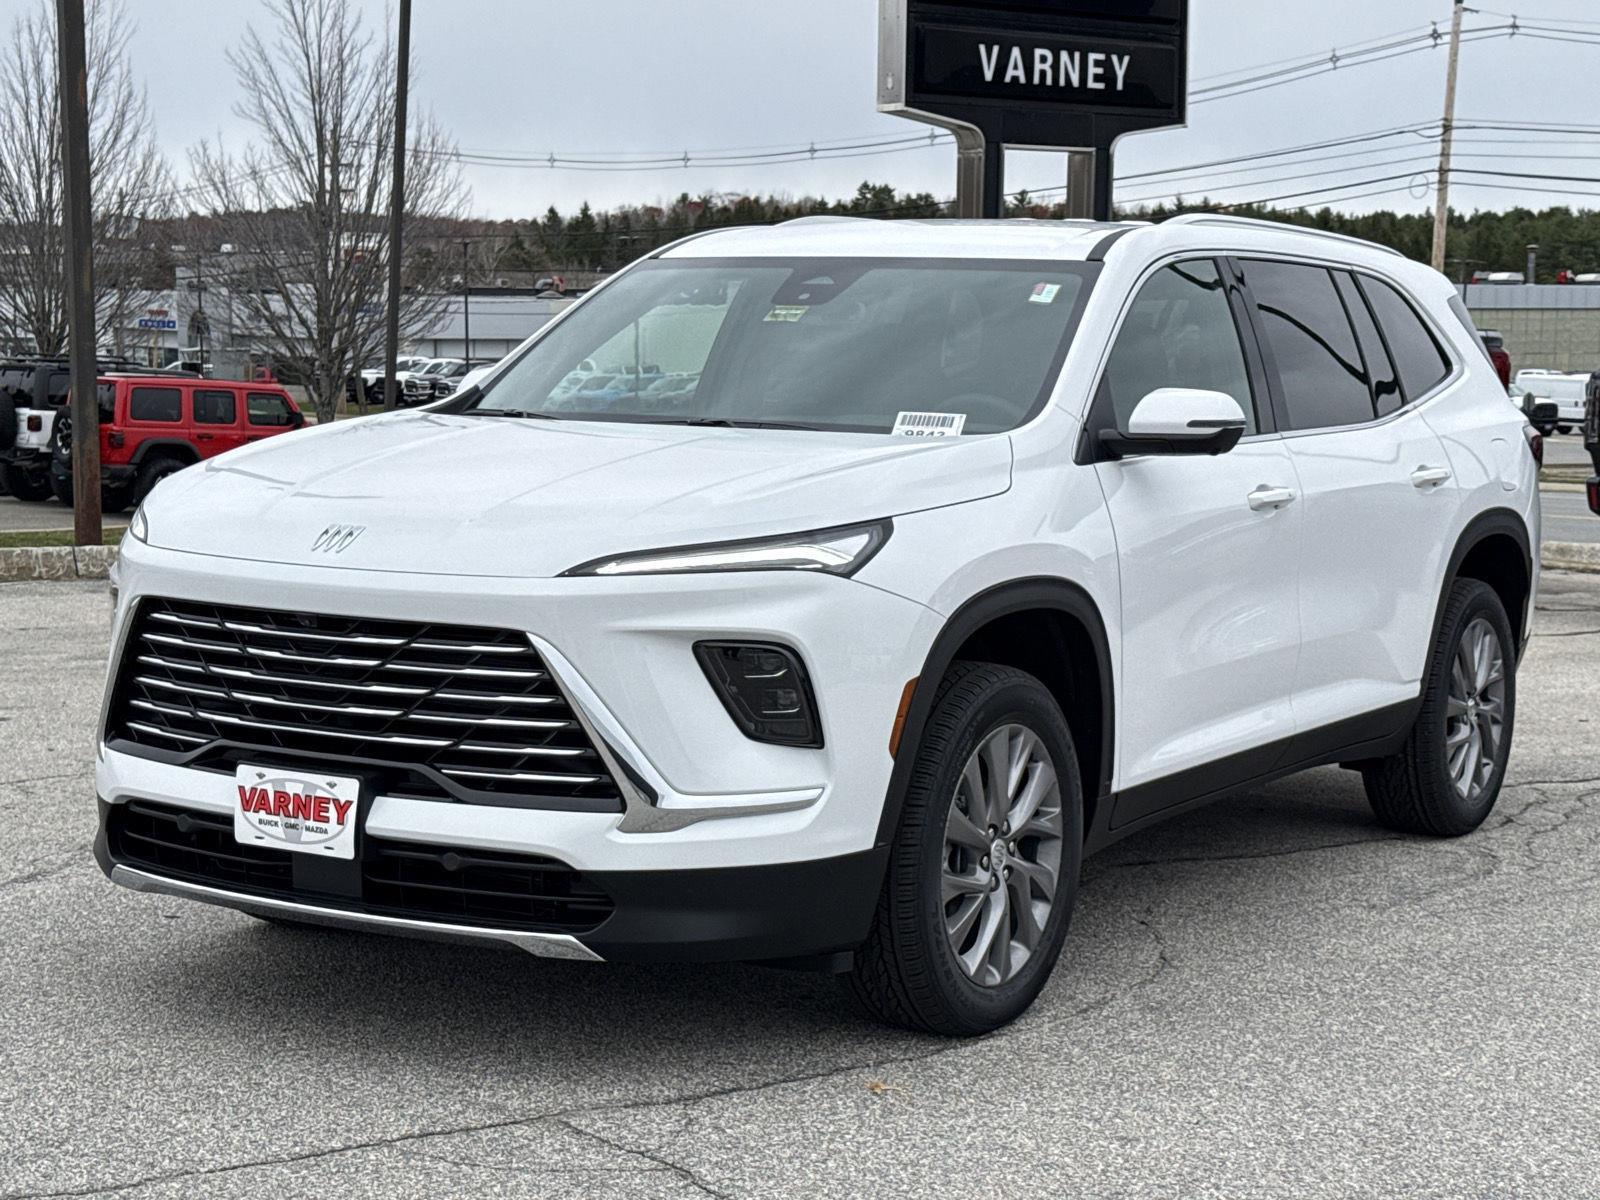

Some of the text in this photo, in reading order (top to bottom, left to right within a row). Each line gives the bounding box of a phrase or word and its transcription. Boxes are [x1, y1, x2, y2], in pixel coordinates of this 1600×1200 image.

[978, 43, 1131, 91] VARNEY
[237, 785, 354, 826] VARNEY
[258, 818, 329, 835] BUICK GMC MAZDA
